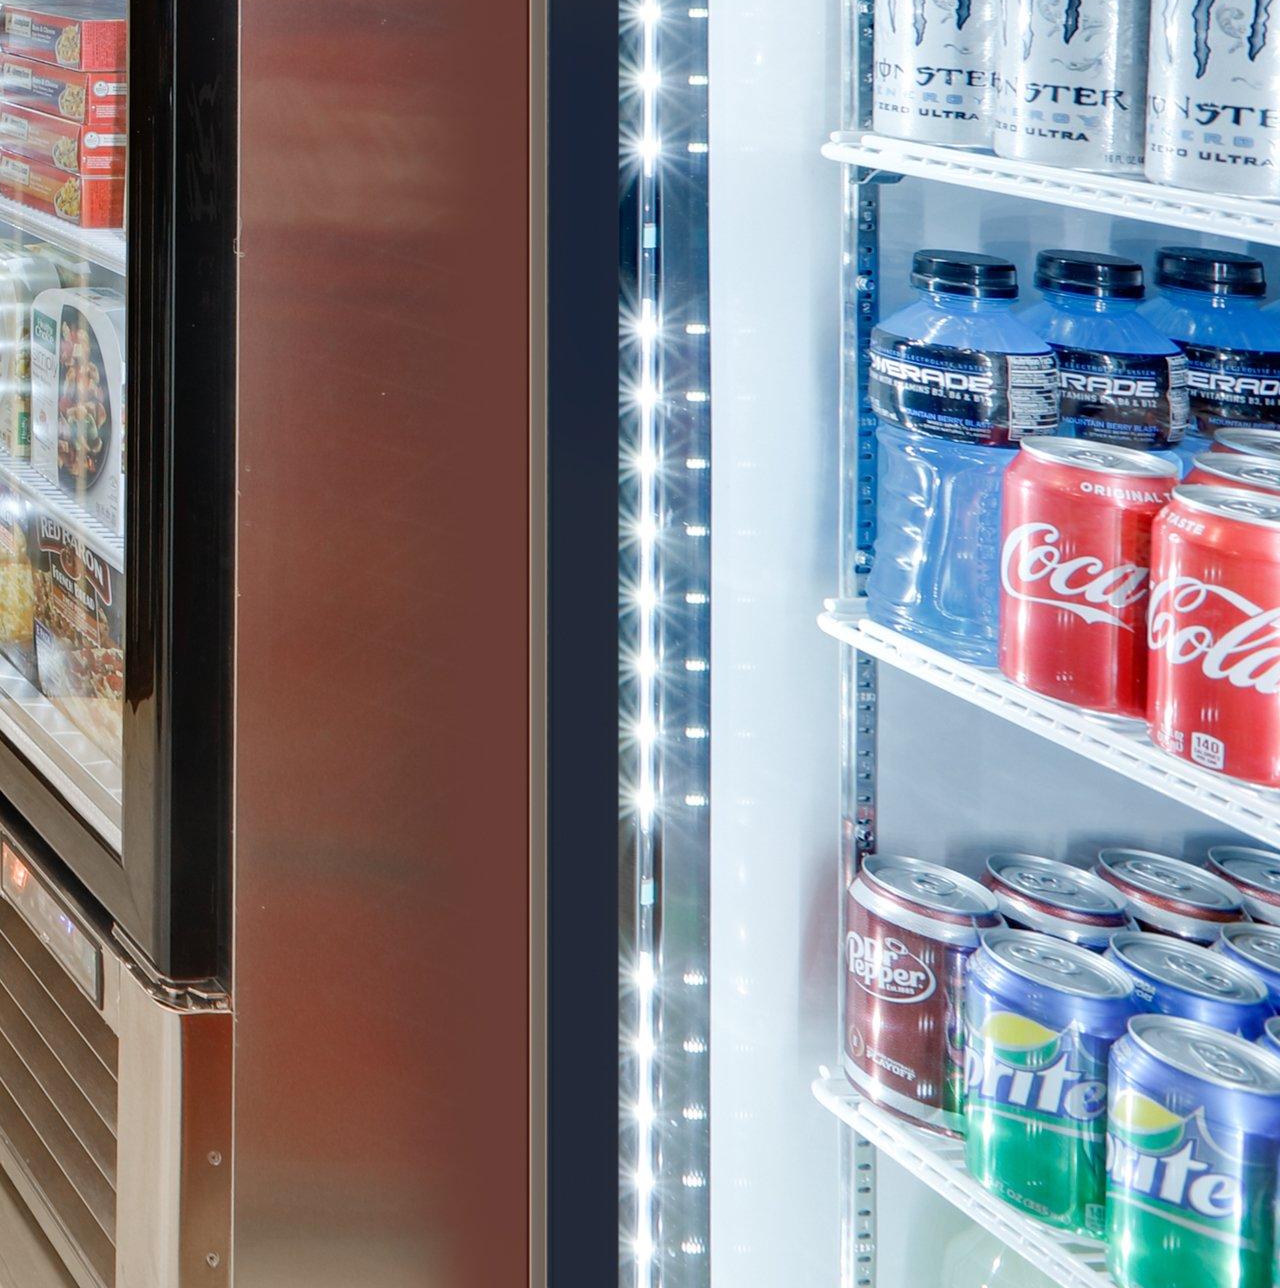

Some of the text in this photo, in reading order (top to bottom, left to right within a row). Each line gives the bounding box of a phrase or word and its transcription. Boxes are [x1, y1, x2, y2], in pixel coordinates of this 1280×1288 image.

[878, 102, 980, 122] ZERO ULTRA
[1025, 126, 1089, 143] ULTRA
[1197, 151, 1276, 169] ULTRA
[1142, 399, 1157, 408] B12
[1201, 391, 1247, 405] VITAMINS
[938, 414, 964, 425] BERRY
[1062, 416, 1159, 434] MOUNTAIN BERRY BLAST
[1079, 481, 1163, 504] ORIGINAL
[1167, 512, 1206, 537] TASTE
[41, 515, 103, 586] RED BARON
[1195, 735, 1220, 754] 140
[863, 937, 900, 963] Dr
[845, 930, 927, 990] Pepper
